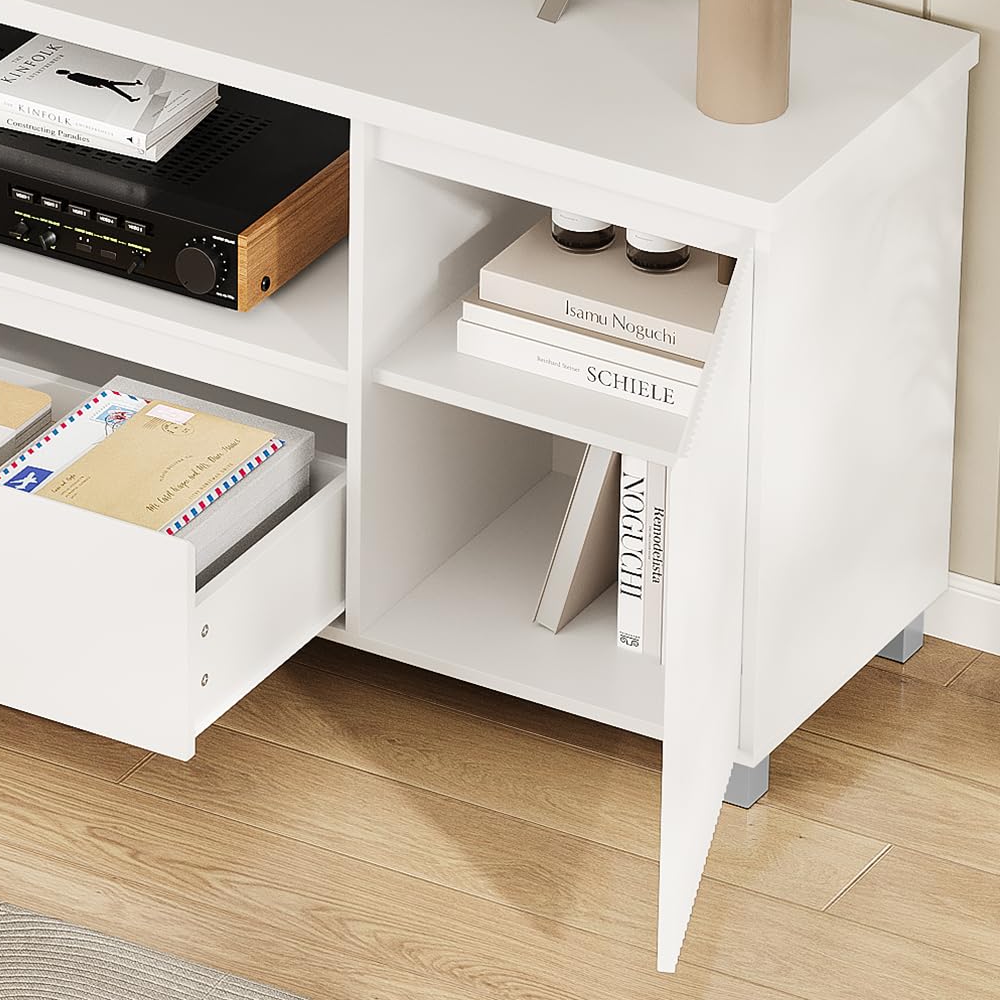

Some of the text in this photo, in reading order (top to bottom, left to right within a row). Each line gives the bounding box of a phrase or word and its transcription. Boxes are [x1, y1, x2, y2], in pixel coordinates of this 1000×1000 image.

[0, 43, 64, 84] KINFOLK
[6, 118, 56, 136] Constructing
[18, 103, 73, 127] KINFOLK
[565, 300, 677, 345] Isamu Noguchi
[586, 366, 676, 405] SCHIELE
[620, 471, 645, 601] NOGUCHI
[652, 507, 665, 584] Remodelista
